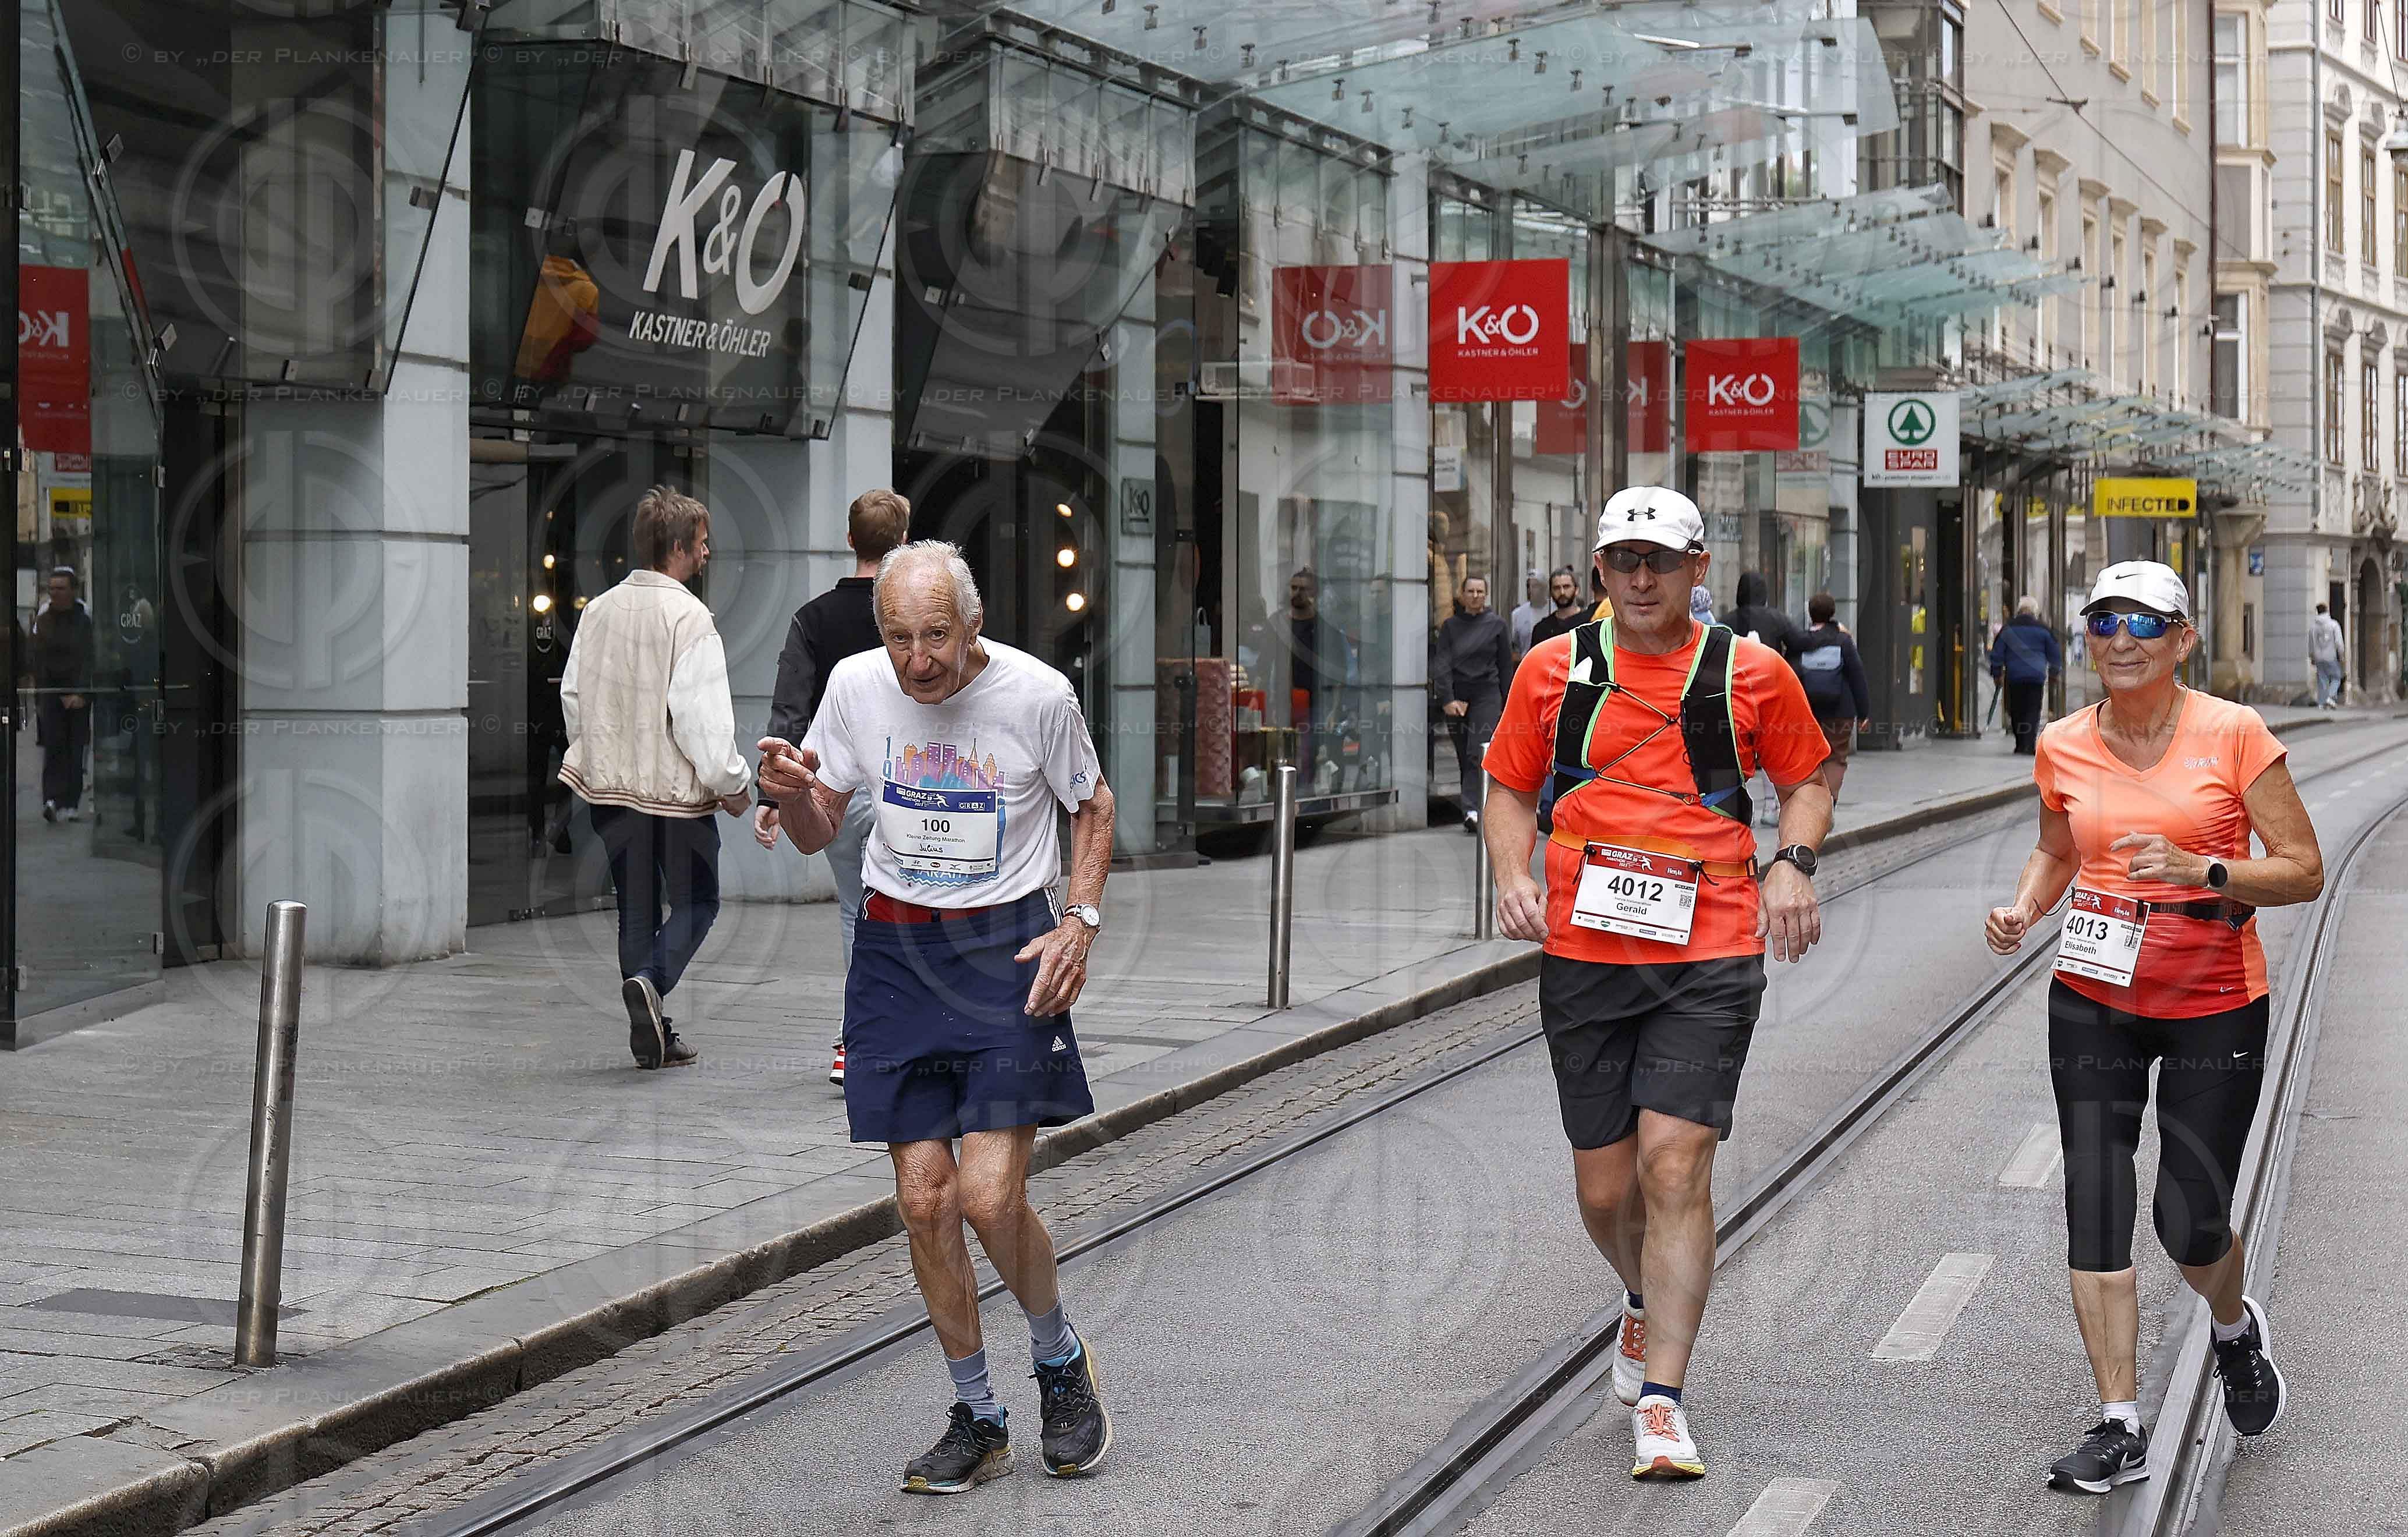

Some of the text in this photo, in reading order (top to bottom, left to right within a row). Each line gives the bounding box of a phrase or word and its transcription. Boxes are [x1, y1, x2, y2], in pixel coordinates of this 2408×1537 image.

[643, 149, 805, 315] K&O
[1458, 304, 1539, 345] K&O
[629, 311, 771, 357] KASTNER & ÖHLER
[1458, 349, 1499, 357] KASTNER
[1709, 373, 1775, 406] K&O
[2107, 498, 2191, 512] INFECTED
[906, 791, 927, 800] GRAZ
[921, 819, 950, 833] 100
[1612, 851, 1634, 860] GRAZ
[1607, 876, 1663, 902] 4012
[1616, 902, 1647, 915] Gerald
[2067, 915, 2108, 940] 4013
[2064, 941, 2097, 955] Elisabeth
